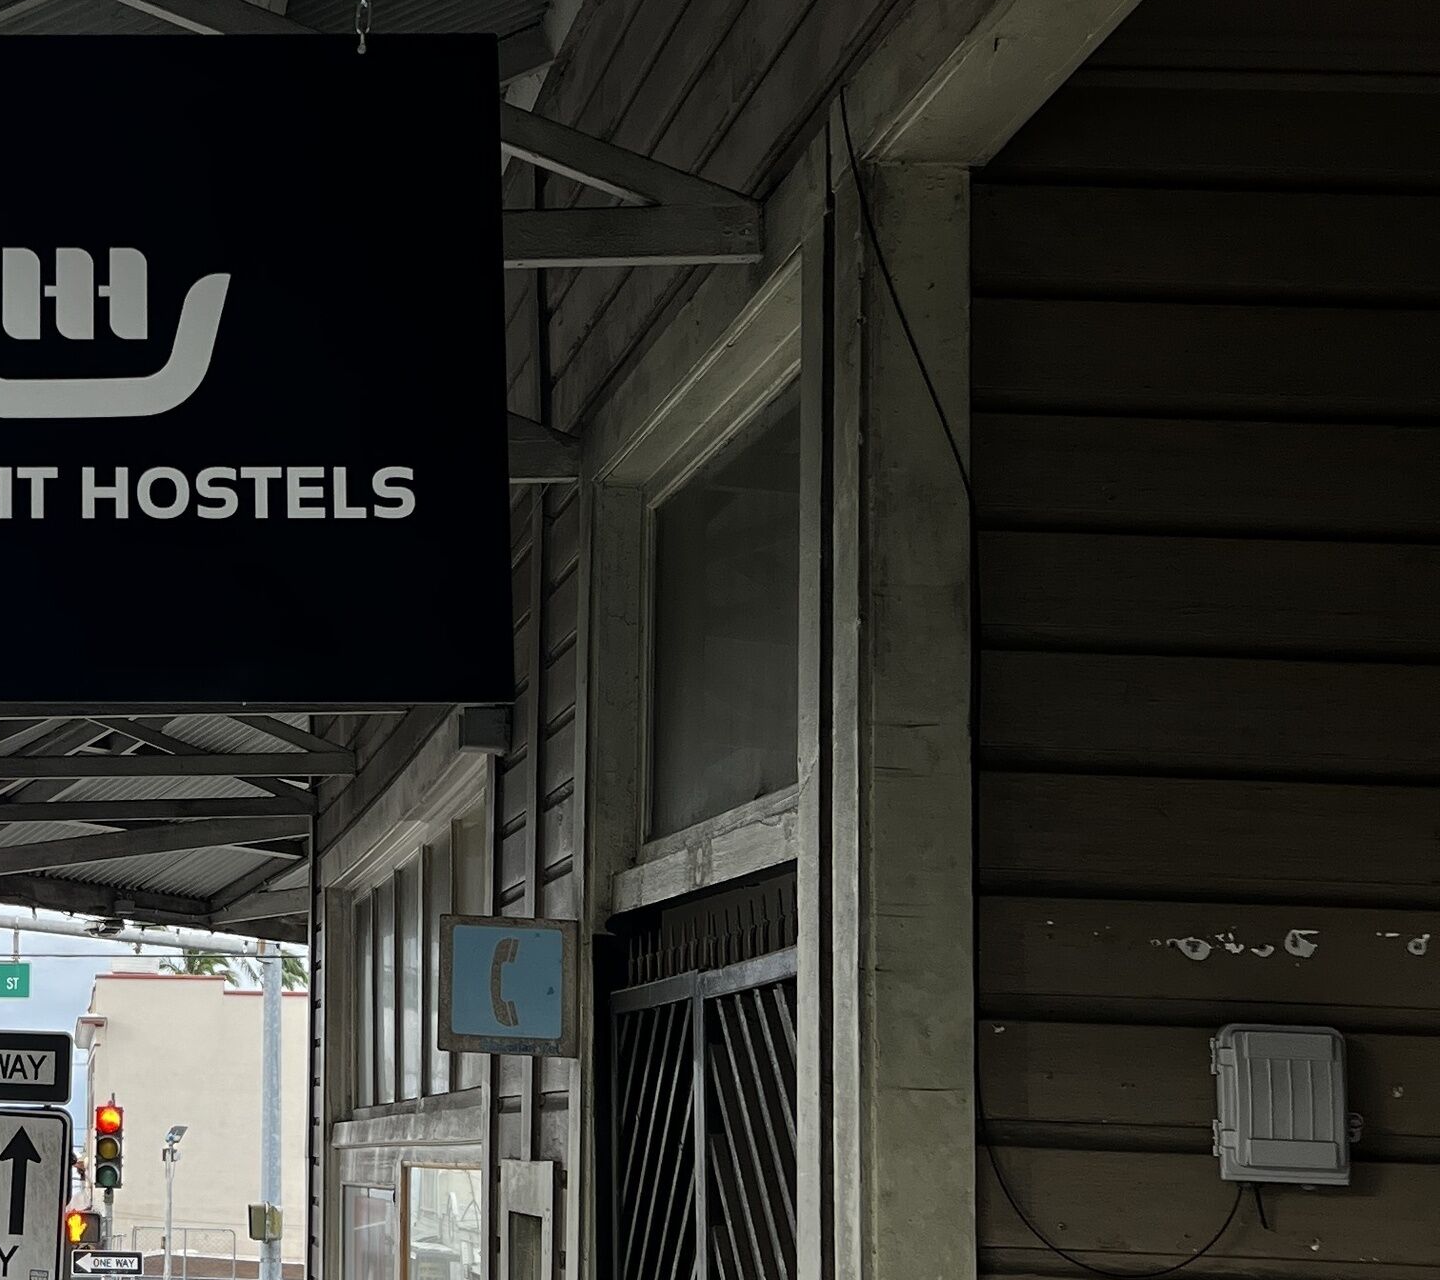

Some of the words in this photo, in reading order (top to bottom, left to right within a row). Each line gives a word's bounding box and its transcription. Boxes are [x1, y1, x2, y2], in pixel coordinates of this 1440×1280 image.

[81, 466, 416, 520] HOSTELS
[6, 977, 20, 990] ST
[93, 1258, 112, 1267] ONE
[115, 1258, 135, 1268] WAY
